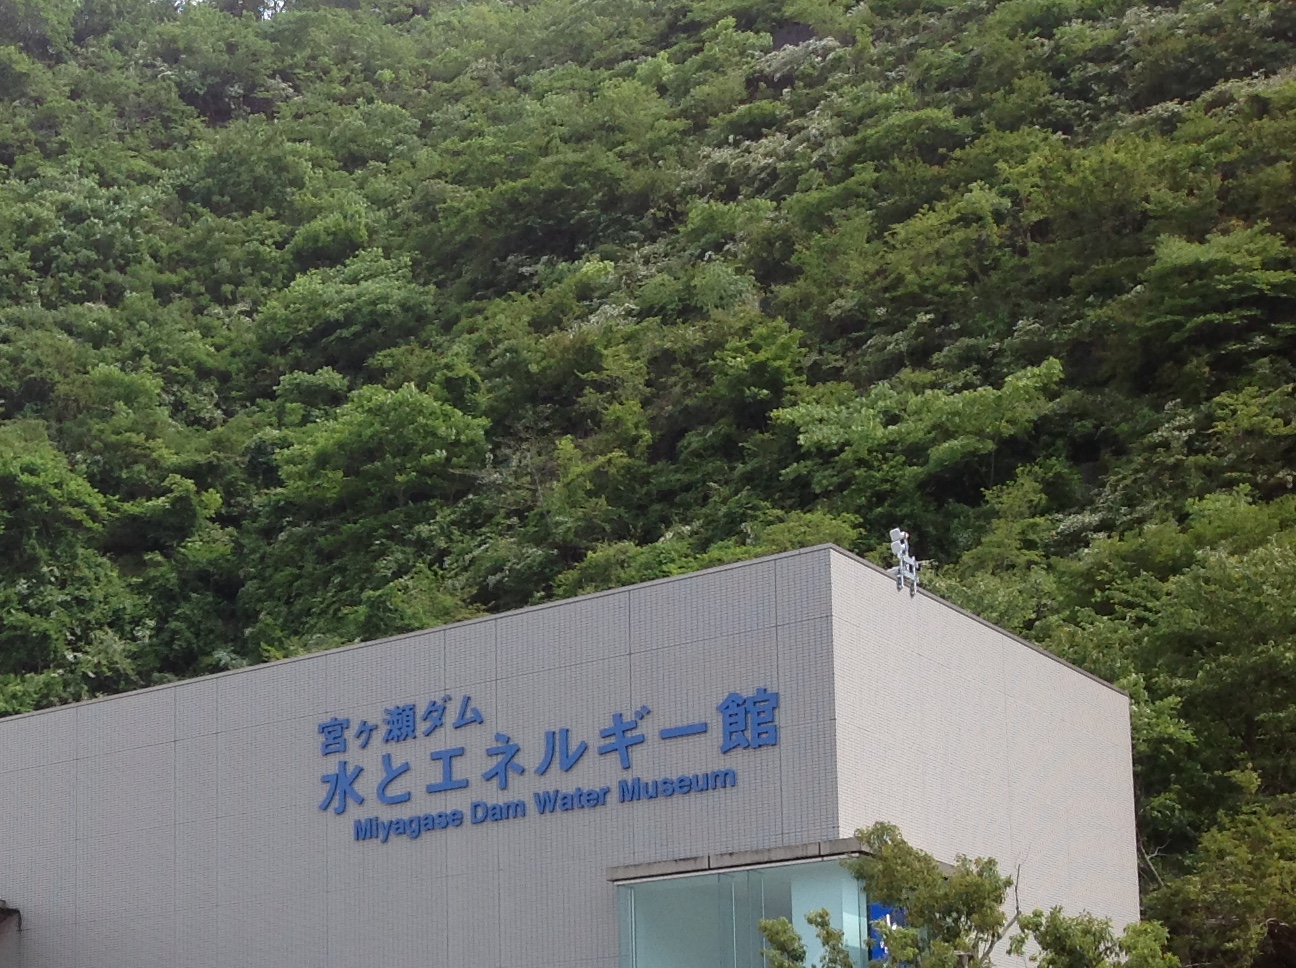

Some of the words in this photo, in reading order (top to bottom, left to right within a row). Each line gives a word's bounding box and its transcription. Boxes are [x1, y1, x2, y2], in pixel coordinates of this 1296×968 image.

[318, 687, 779, 815] 水とエネルギー館
[354, 809, 464, 843] Miyagase
[471, 800, 526, 824] Dam
[534, 786, 610, 815] Water
[618, 767, 737, 803] Museum
